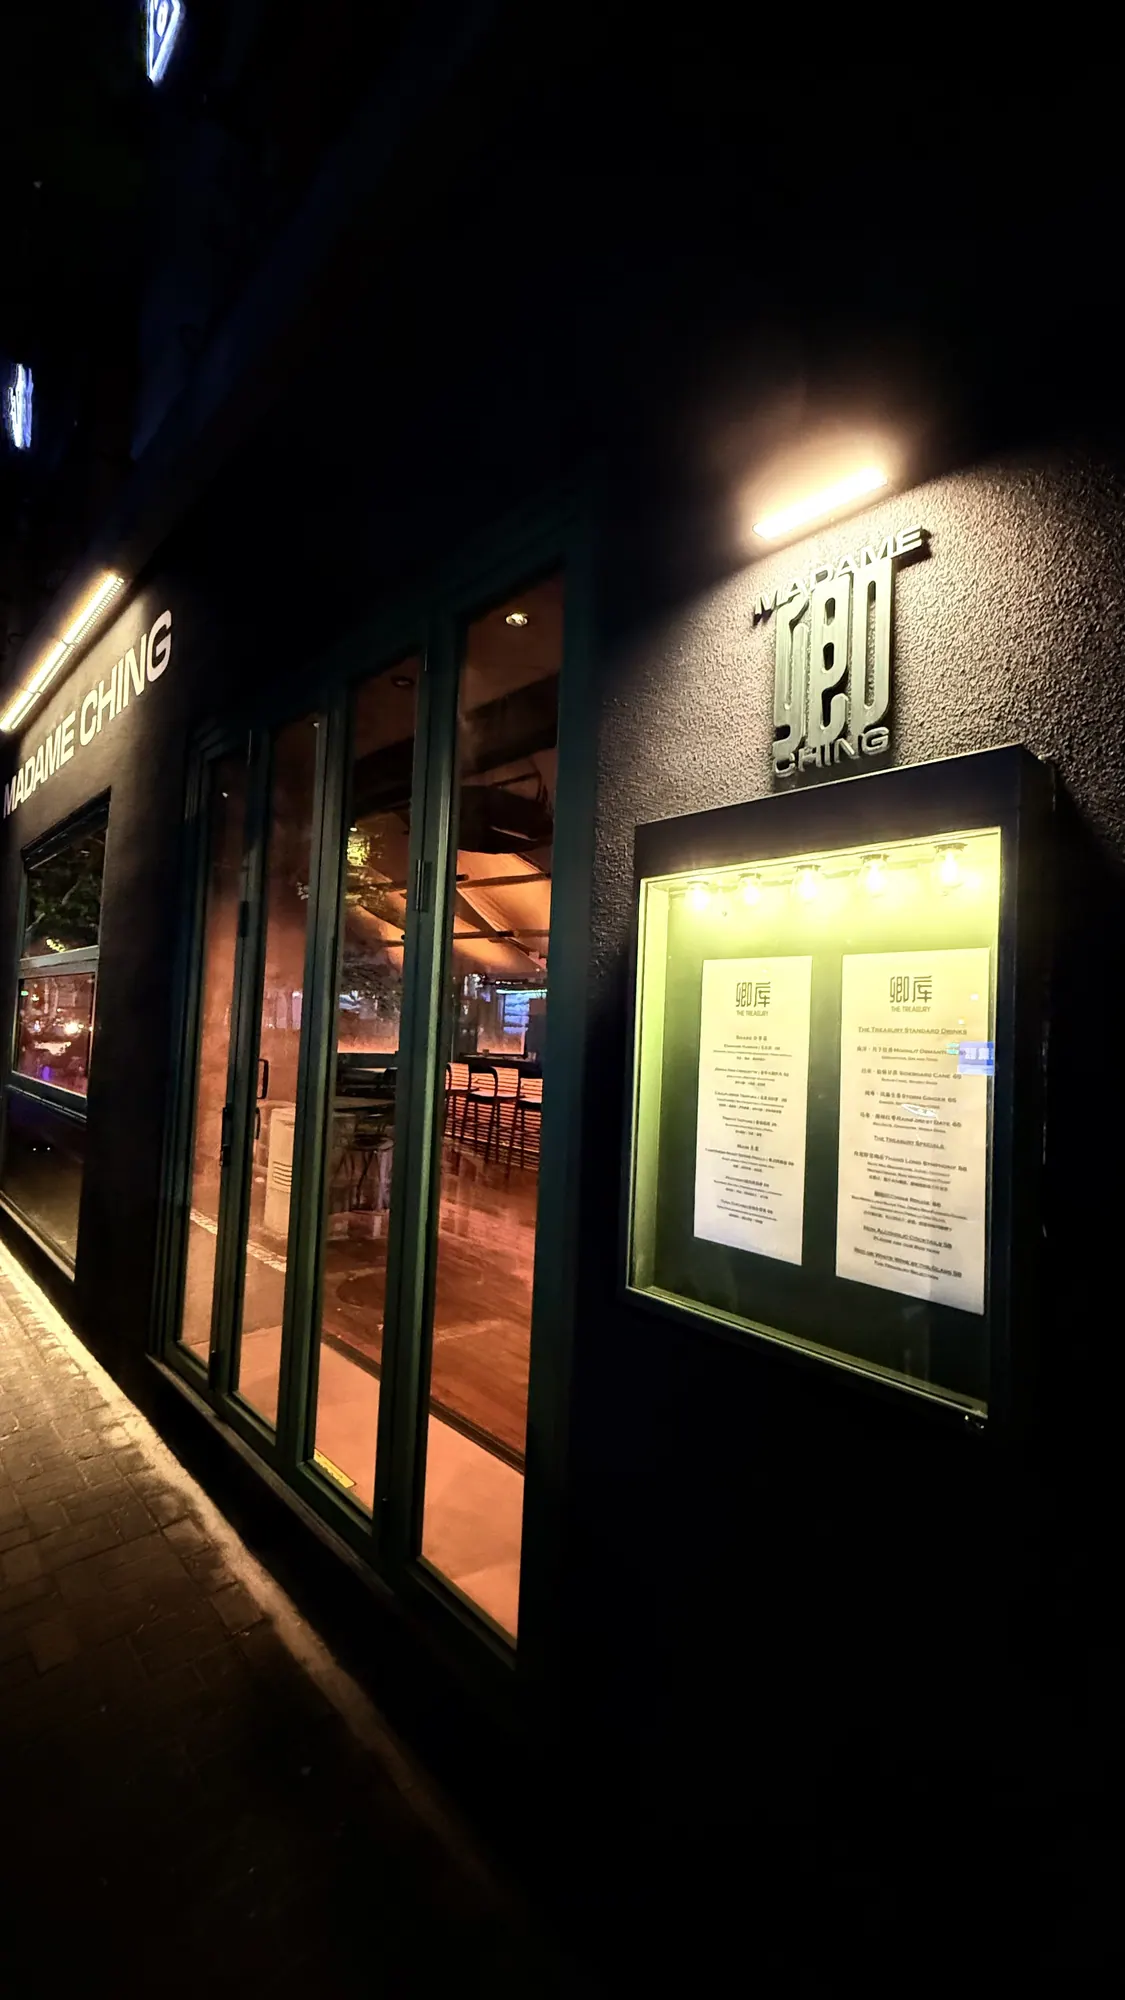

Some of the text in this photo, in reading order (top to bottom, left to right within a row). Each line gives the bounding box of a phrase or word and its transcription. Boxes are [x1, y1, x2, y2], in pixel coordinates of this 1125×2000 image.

[755, 524, 924, 616] MADAME
[3, 609, 173, 818] MADAME CHING
[772, 726, 891, 778] CHING
[871, 1026, 903, 1034] TREASURY
[904, 1026, 940, 1035] STANDARD
